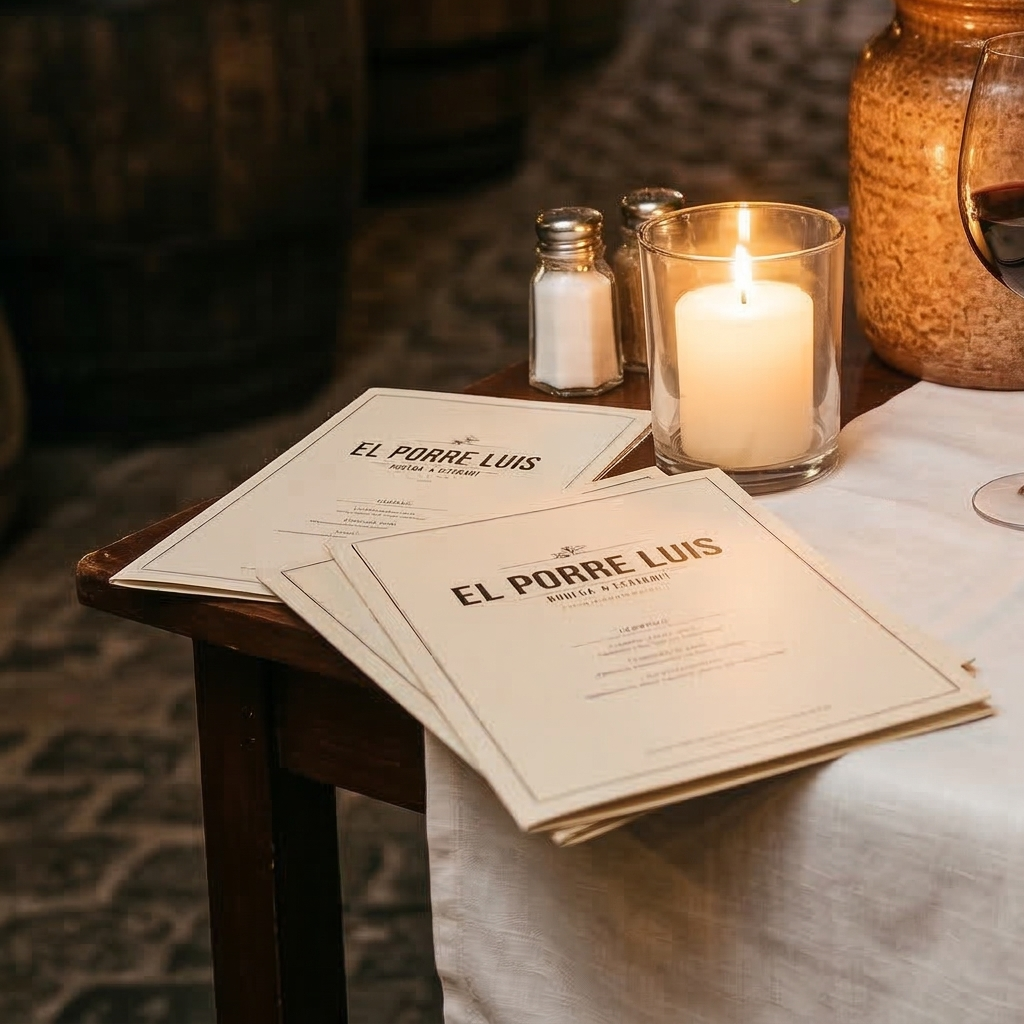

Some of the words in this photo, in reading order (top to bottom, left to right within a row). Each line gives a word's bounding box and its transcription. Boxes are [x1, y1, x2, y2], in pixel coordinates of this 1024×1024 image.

[350, 442, 382, 458] EL
[387, 445, 479, 466] PORRE
[479, 453, 542, 471] LUIS
[450, 583, 504, 607] EL
[507, 554, 636, 595] PORRE
[636, 537, 723, 568] LUIS
